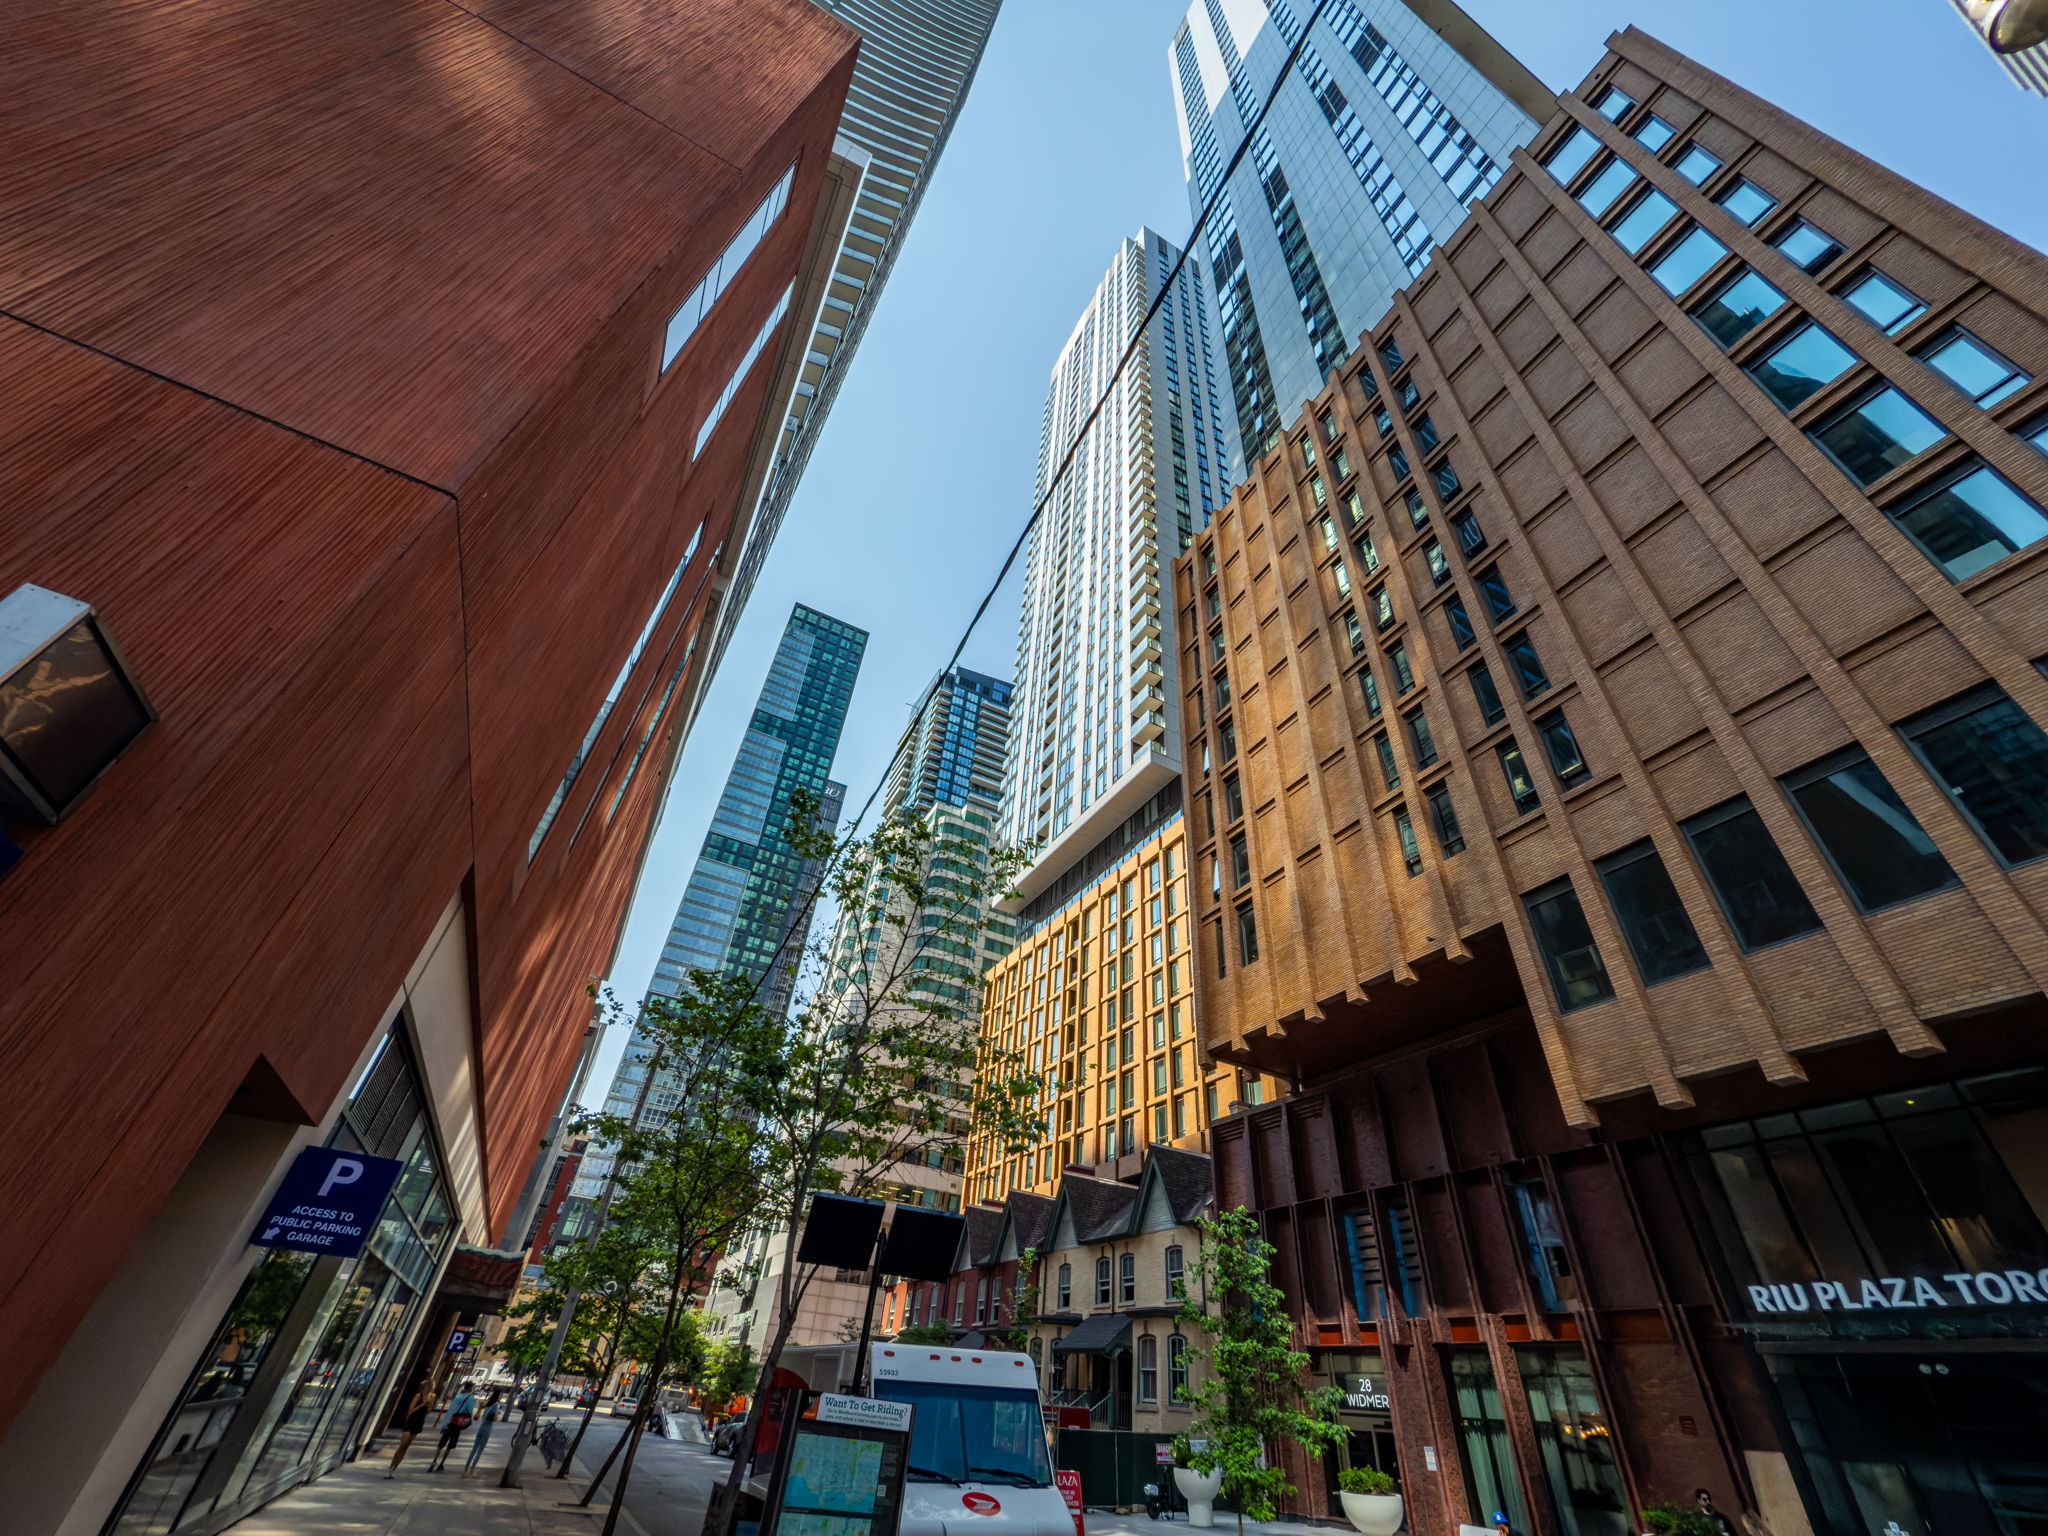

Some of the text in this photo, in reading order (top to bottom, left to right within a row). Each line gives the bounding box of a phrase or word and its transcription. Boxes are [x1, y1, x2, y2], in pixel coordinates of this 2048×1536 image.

[317, 1157, 364, 1196] P
[291, 1205, 355, 1222] ACCESS TO
[270, 1215, 362, 1236] PUBLIC PARKING
[286, 1231, 334, 1246] GARAGE
[1748, 1282, 1811, 1312] RIU
[1811, 1276, 1948, 1310] PLAZA
[448, 1331, 465, 1350] P
[1358, 1378, 1372, 1392] 28
[825, 1396, 847, 1409] Want
[848, 1399, 860, 1410] To
[860, 1401, 876, 1412] Get
[877, 1403, 909, 1419] Riding?
[1345, 1393, 1390, 1408] WIDMER
[1057, 1475, 1079, 1487] LAZA
